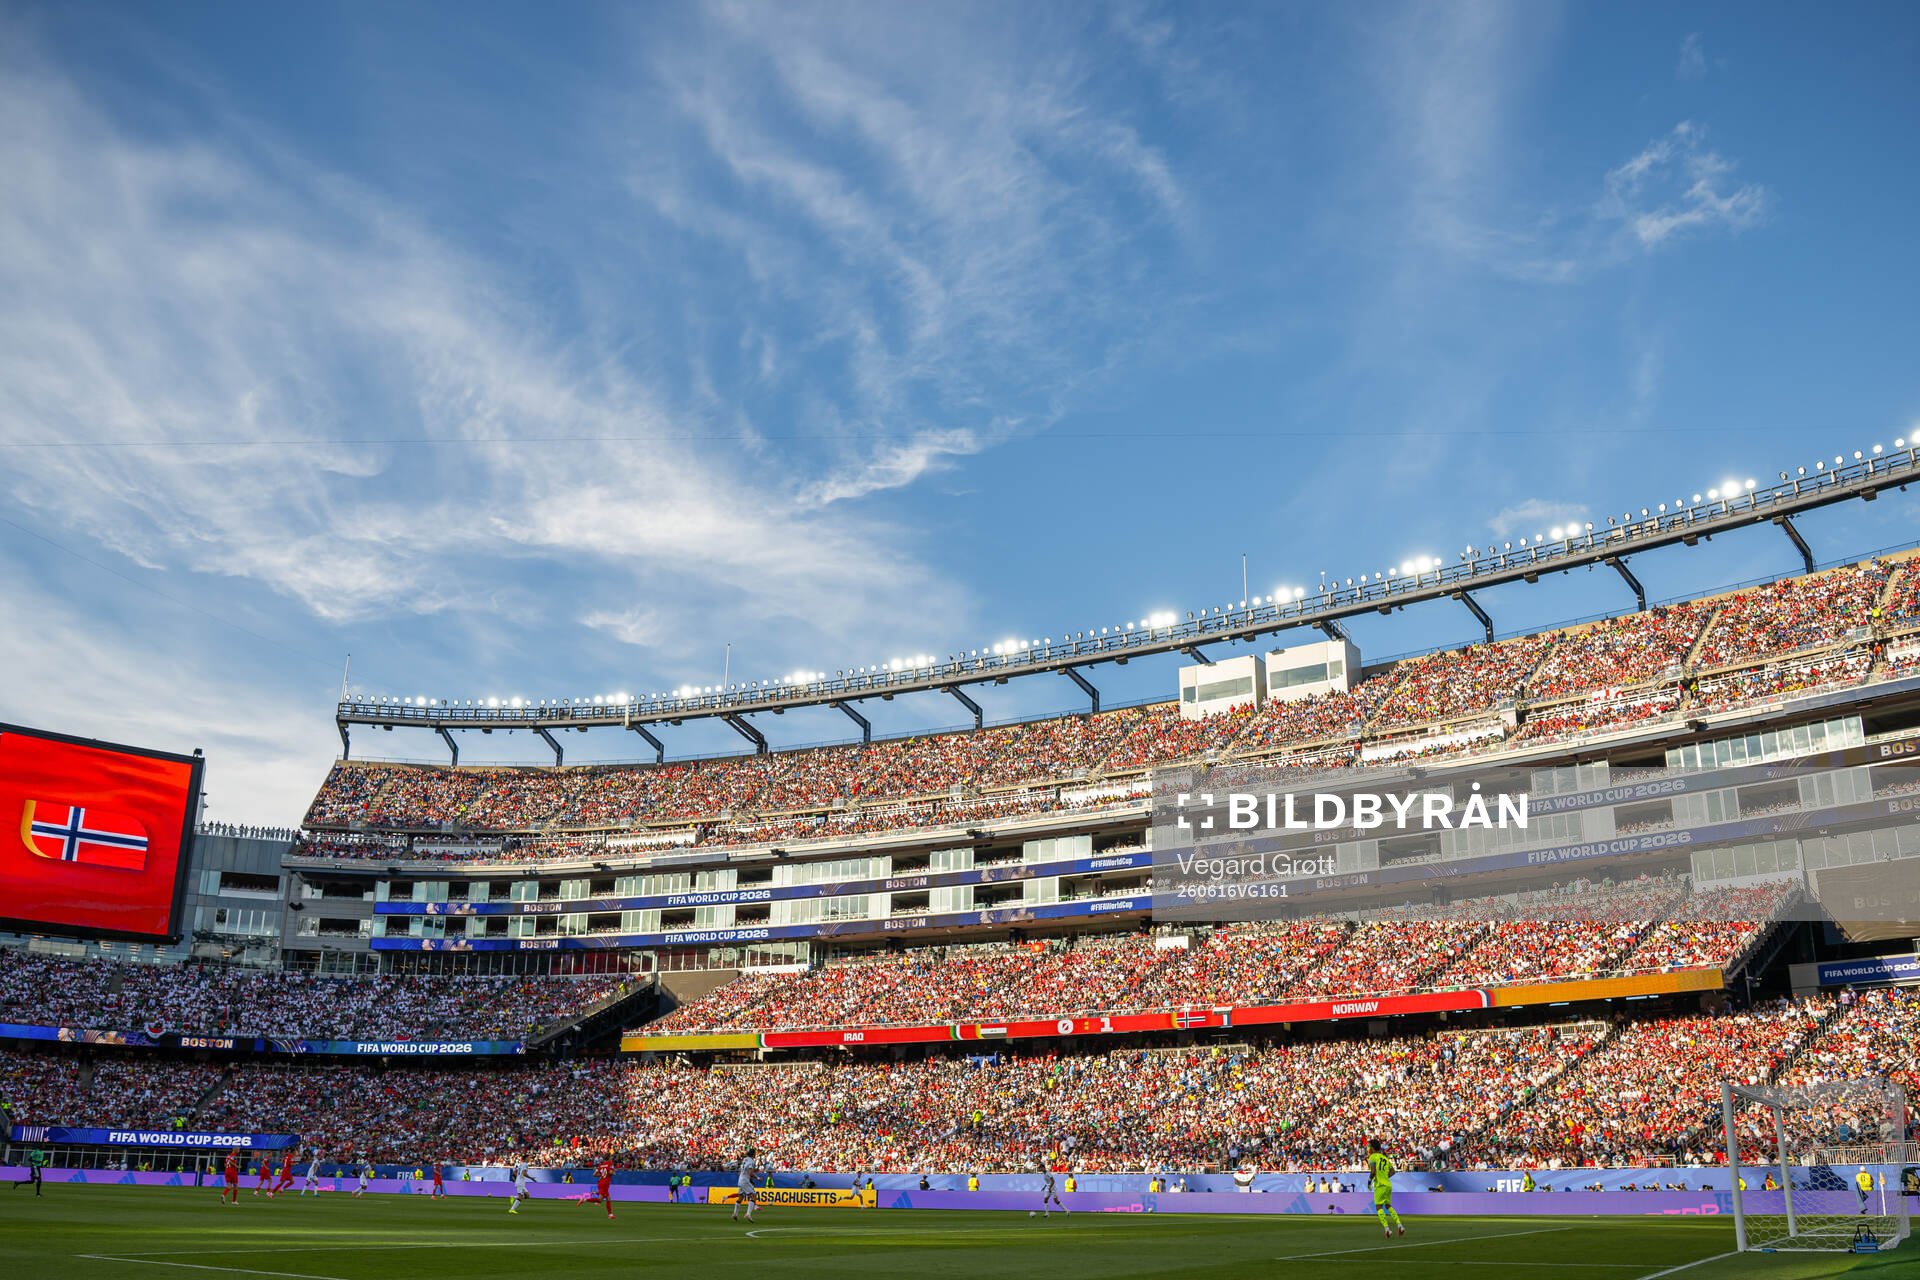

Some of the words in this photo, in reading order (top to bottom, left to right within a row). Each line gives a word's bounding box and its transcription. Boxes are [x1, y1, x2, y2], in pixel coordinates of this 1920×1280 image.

[1880, 740, 1920, 757] BOS
[1554, 793, 1603, 809] WORLD
[1605, 787, 1633, 801] CUP
[1636, 779, 1686, 797] 2026
[1528, 851, 1557, 863] FIFA
[1559, 844, 1607, 859] WORLD
[1610, 839, 1638, 853] CUP
[1641, 831, 1691, 848] 2026
[885, 877, 927, 889] BOSTON
[1316, 873, 1369, 889] BOSTON
[668, 896, 686, 904] FIFA
[688, 894, 719, 903] WORLD
[721, 892, 738, 901] CUP
[739, 890, 771, 900] 2026
[523, 903, 562, 912] BOSTON
[884, 918, 926, 929] BOSTON
[665, 934, 684, 943] FIFA
[685, 932, 716, 942] WORLD
[718, 931, 736, 940] CUP
[737, 929, 769, 939] 2026
[520, 940, 559, 949] BOSTON
[1824, 970, 1843, 978] FIFA
[1843, 966, 1874, 976] WORLD
[1332, 1001, 1379, 1015] NORWAY
[1100, 1017, 1114, 1032] 1
[181, 1037, 234, 1049] BOSTON
[844, 1033, 864, 1041] IRAQ
[357, 1043, 379, 1052] FIFA
[381, 1043, 417, 1053] WORLD
[419, 1043, 438, 1053] CUP
[439, 1043, 472, 1053] 2026
[109, 1132, 137, 1143] FIFA
[139, 1133, 184, 1145] WORLD
[186, 1134, 211, 1146] CUP
[213, 1136, 251, 1146] 2026
